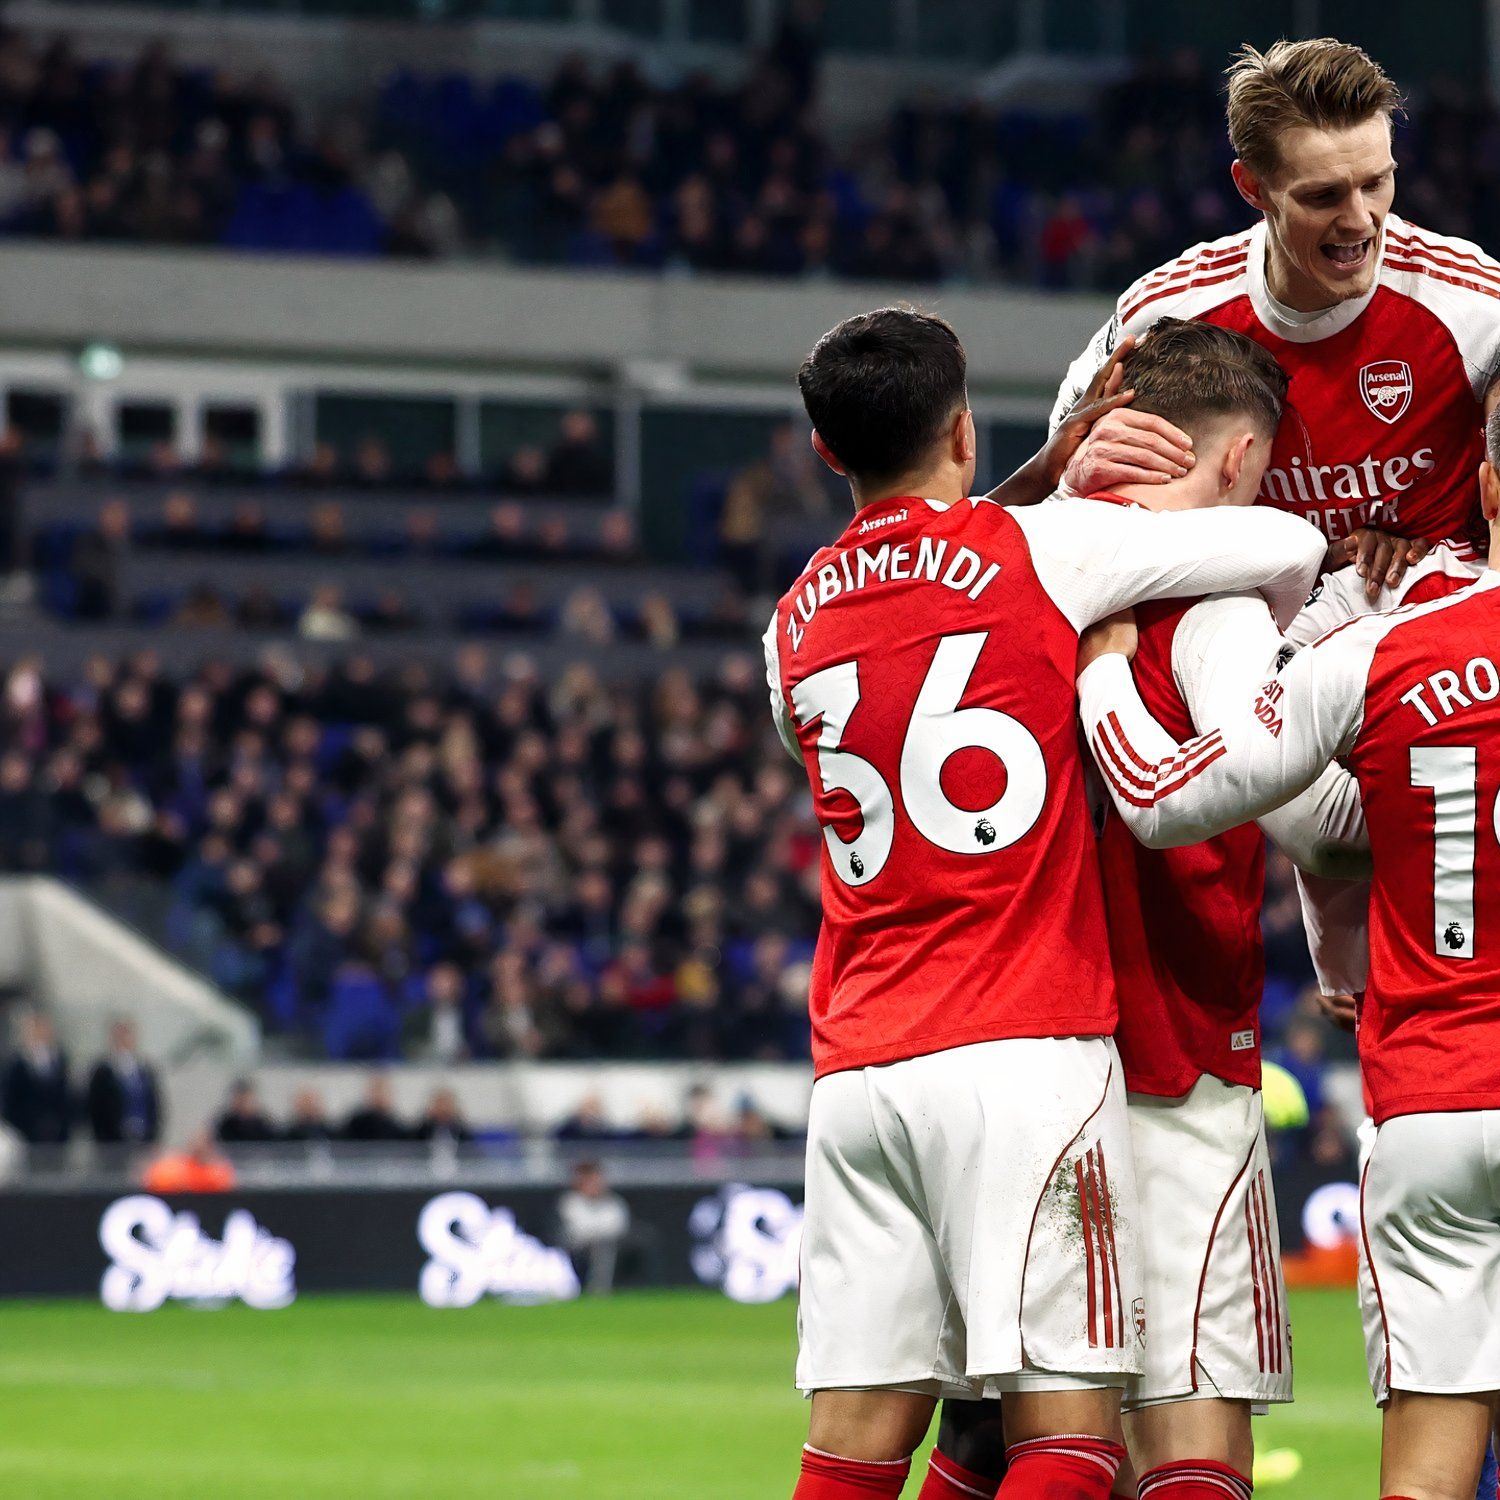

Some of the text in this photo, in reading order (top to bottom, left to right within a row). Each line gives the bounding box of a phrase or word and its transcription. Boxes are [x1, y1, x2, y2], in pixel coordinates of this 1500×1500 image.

[1367, 369, 1405, 383] Arsenal
[1257, 447, 1436, 502] mirates
[858, 508, 908, 535] Arsenal
[786, 537, 1001, 652] ZUBIMENDI
[791, 632, 1047, 886] 36
